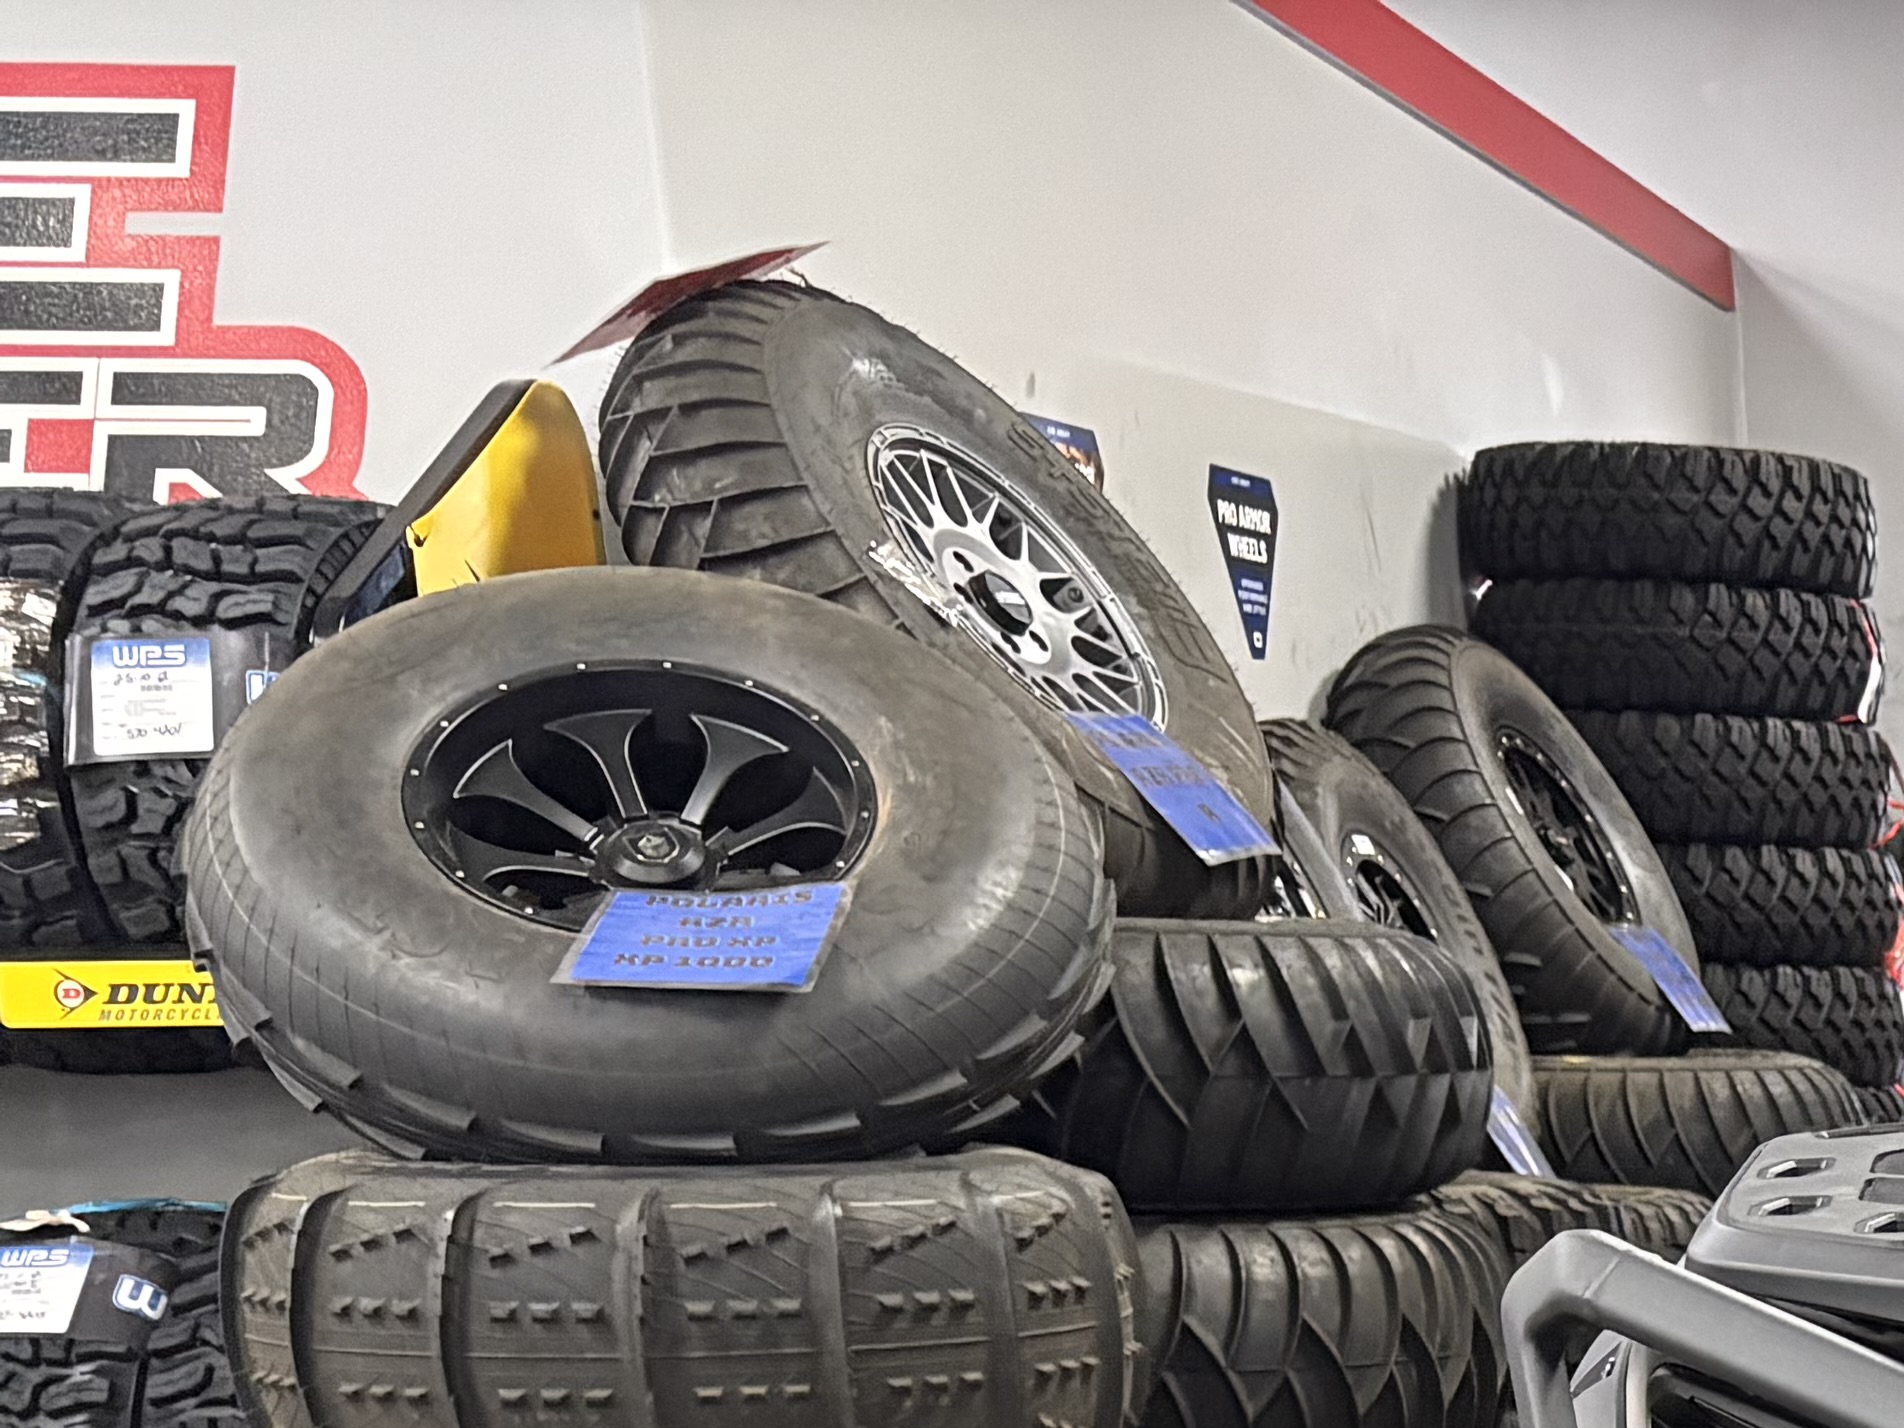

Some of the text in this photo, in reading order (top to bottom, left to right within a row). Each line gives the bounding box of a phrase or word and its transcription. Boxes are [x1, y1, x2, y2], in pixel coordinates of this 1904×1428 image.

[1217, 499, 1271, 534] PRO ARMOR
[1227, 532, 1268, 564] WHEELS
[112, 645, 186, 667] WPS
[646, 890, 813, 908] POLARIS
[674, 956, 773, 969] 1000
[99, 1008, 224, 1022] MOTORCYCL
[1, 1249, 70, 1267] WPS
